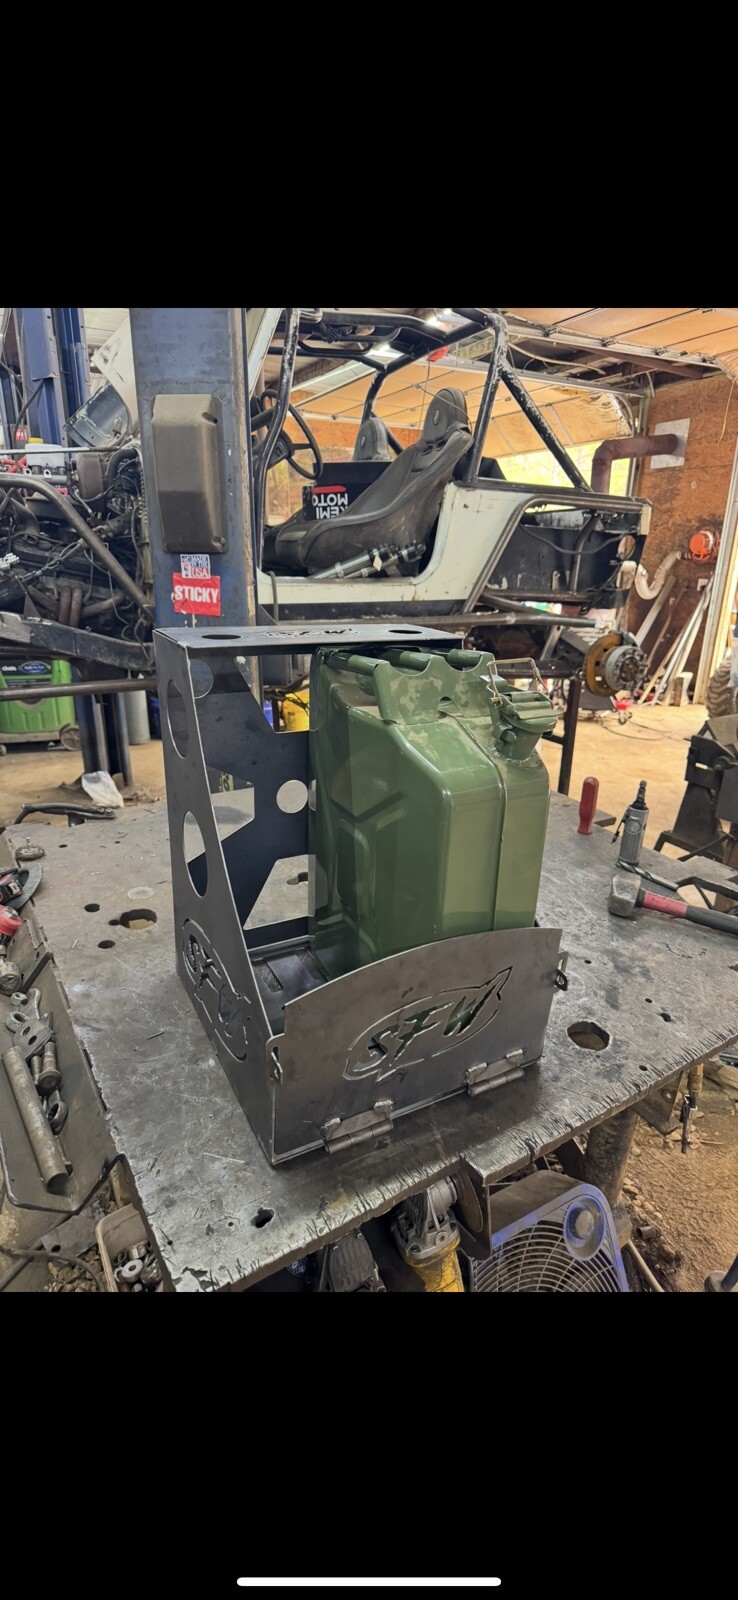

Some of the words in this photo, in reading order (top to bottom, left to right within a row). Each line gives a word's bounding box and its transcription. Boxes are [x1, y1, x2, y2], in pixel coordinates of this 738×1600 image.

[312, 493, 348, 506] MOTO
[191, 567, 209, 578] USA
[174, 585, 219, 603] STICKY
[353, 980, 500, 1072] SFW
